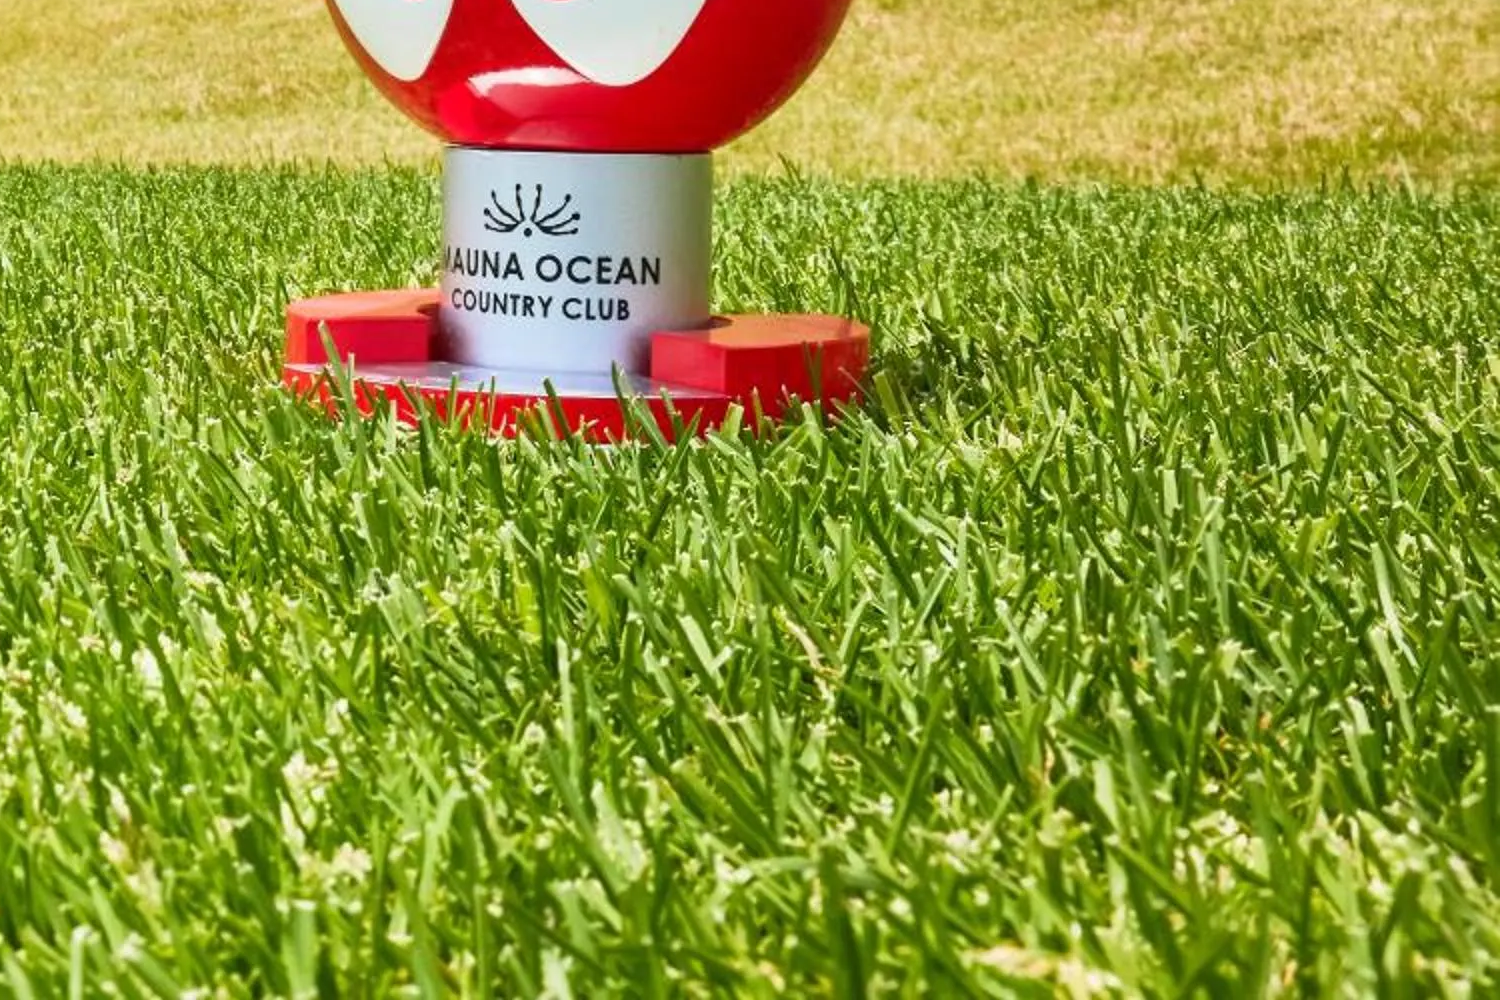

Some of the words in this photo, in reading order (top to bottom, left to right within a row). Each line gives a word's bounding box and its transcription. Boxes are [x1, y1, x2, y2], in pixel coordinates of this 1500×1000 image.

[535, 255, 661, 285] OCEAN
[451, 287, 553, 318] COUNTRY
[561, 297, 631, 321] CLUB
